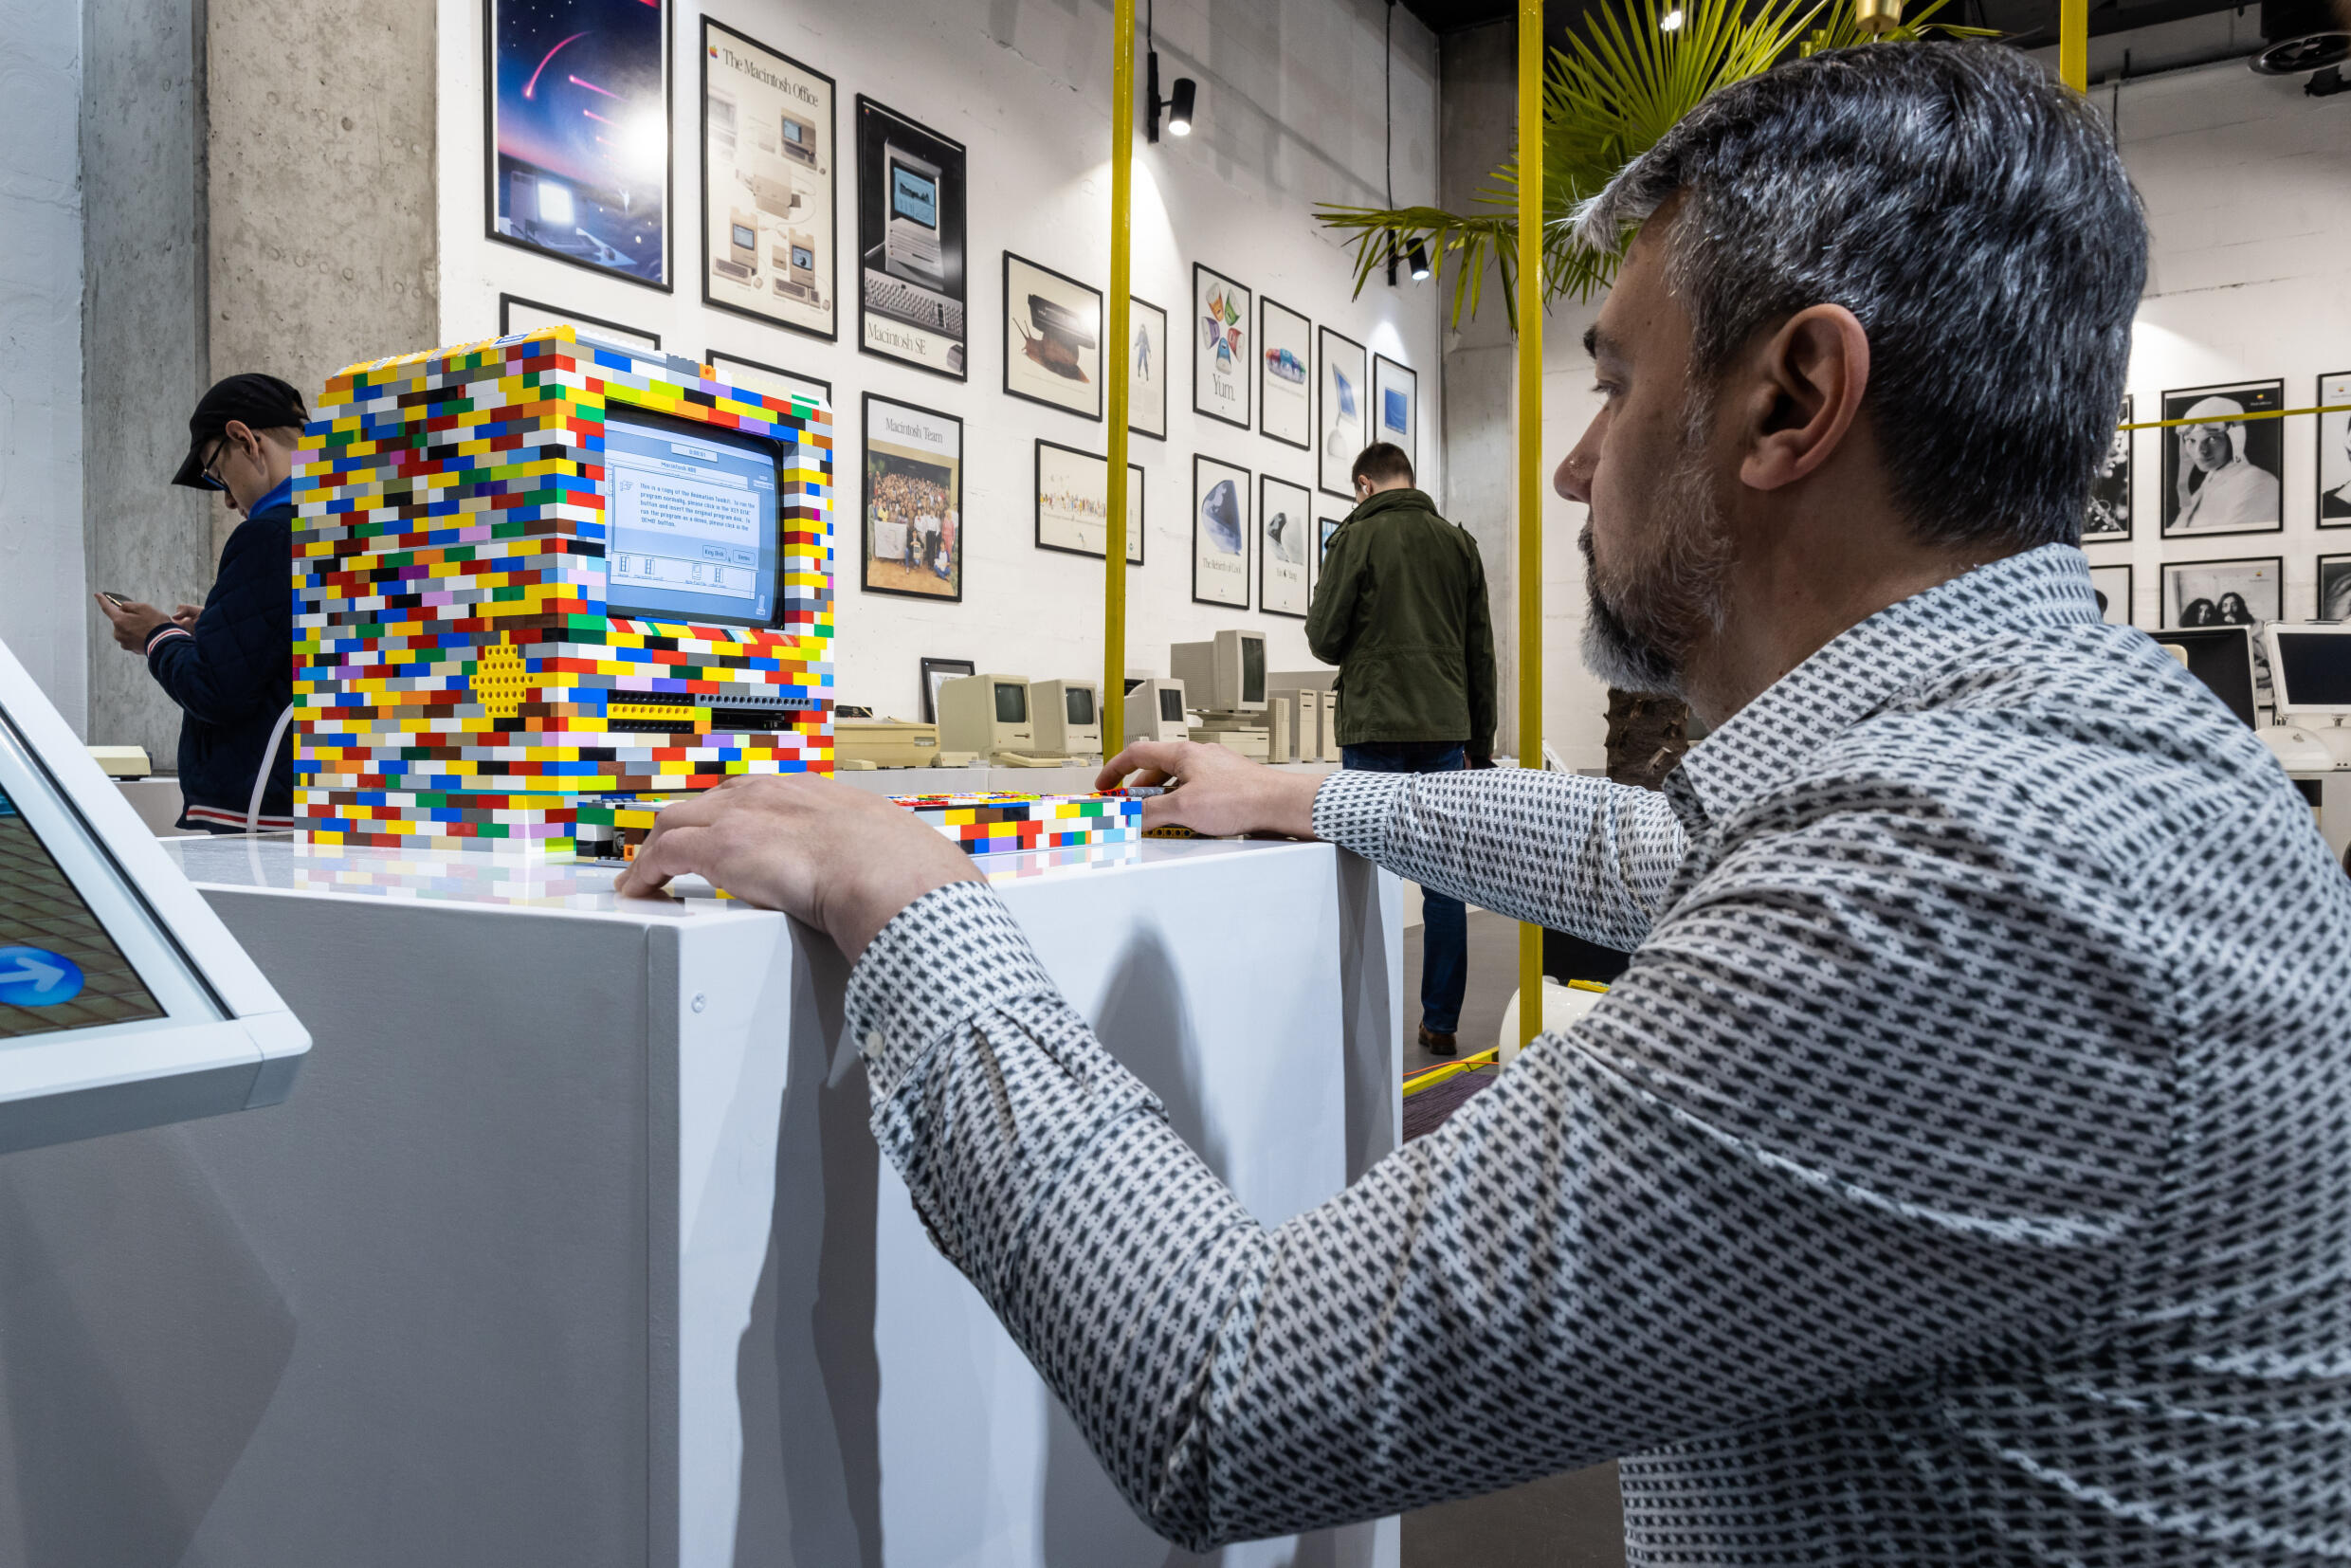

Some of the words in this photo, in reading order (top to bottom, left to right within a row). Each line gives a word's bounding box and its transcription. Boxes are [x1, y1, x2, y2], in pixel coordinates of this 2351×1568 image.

[723, 48, 742, 72] The
[744, 59, 791, 95] Macintosh
[793, 82, 819, 107] Office
[867, 321, 913, 351] Macintosh
[915, 337, 926, 356] SE
[1212, 373, 1236, 402] Yum.
[885, 417, 921, 439] Macintosh
[923, 426, 943, 444] Team
[661, 462, 686, 471] Macintosh
[662, 487, 674, 496] copy
[691, 492, 715, 501] Animation
[640, 500, 658, 508] button
[669, 504, 684, 513] insert
[660, 512, 682, 520] program
[704, 549, 715, 557] Key
